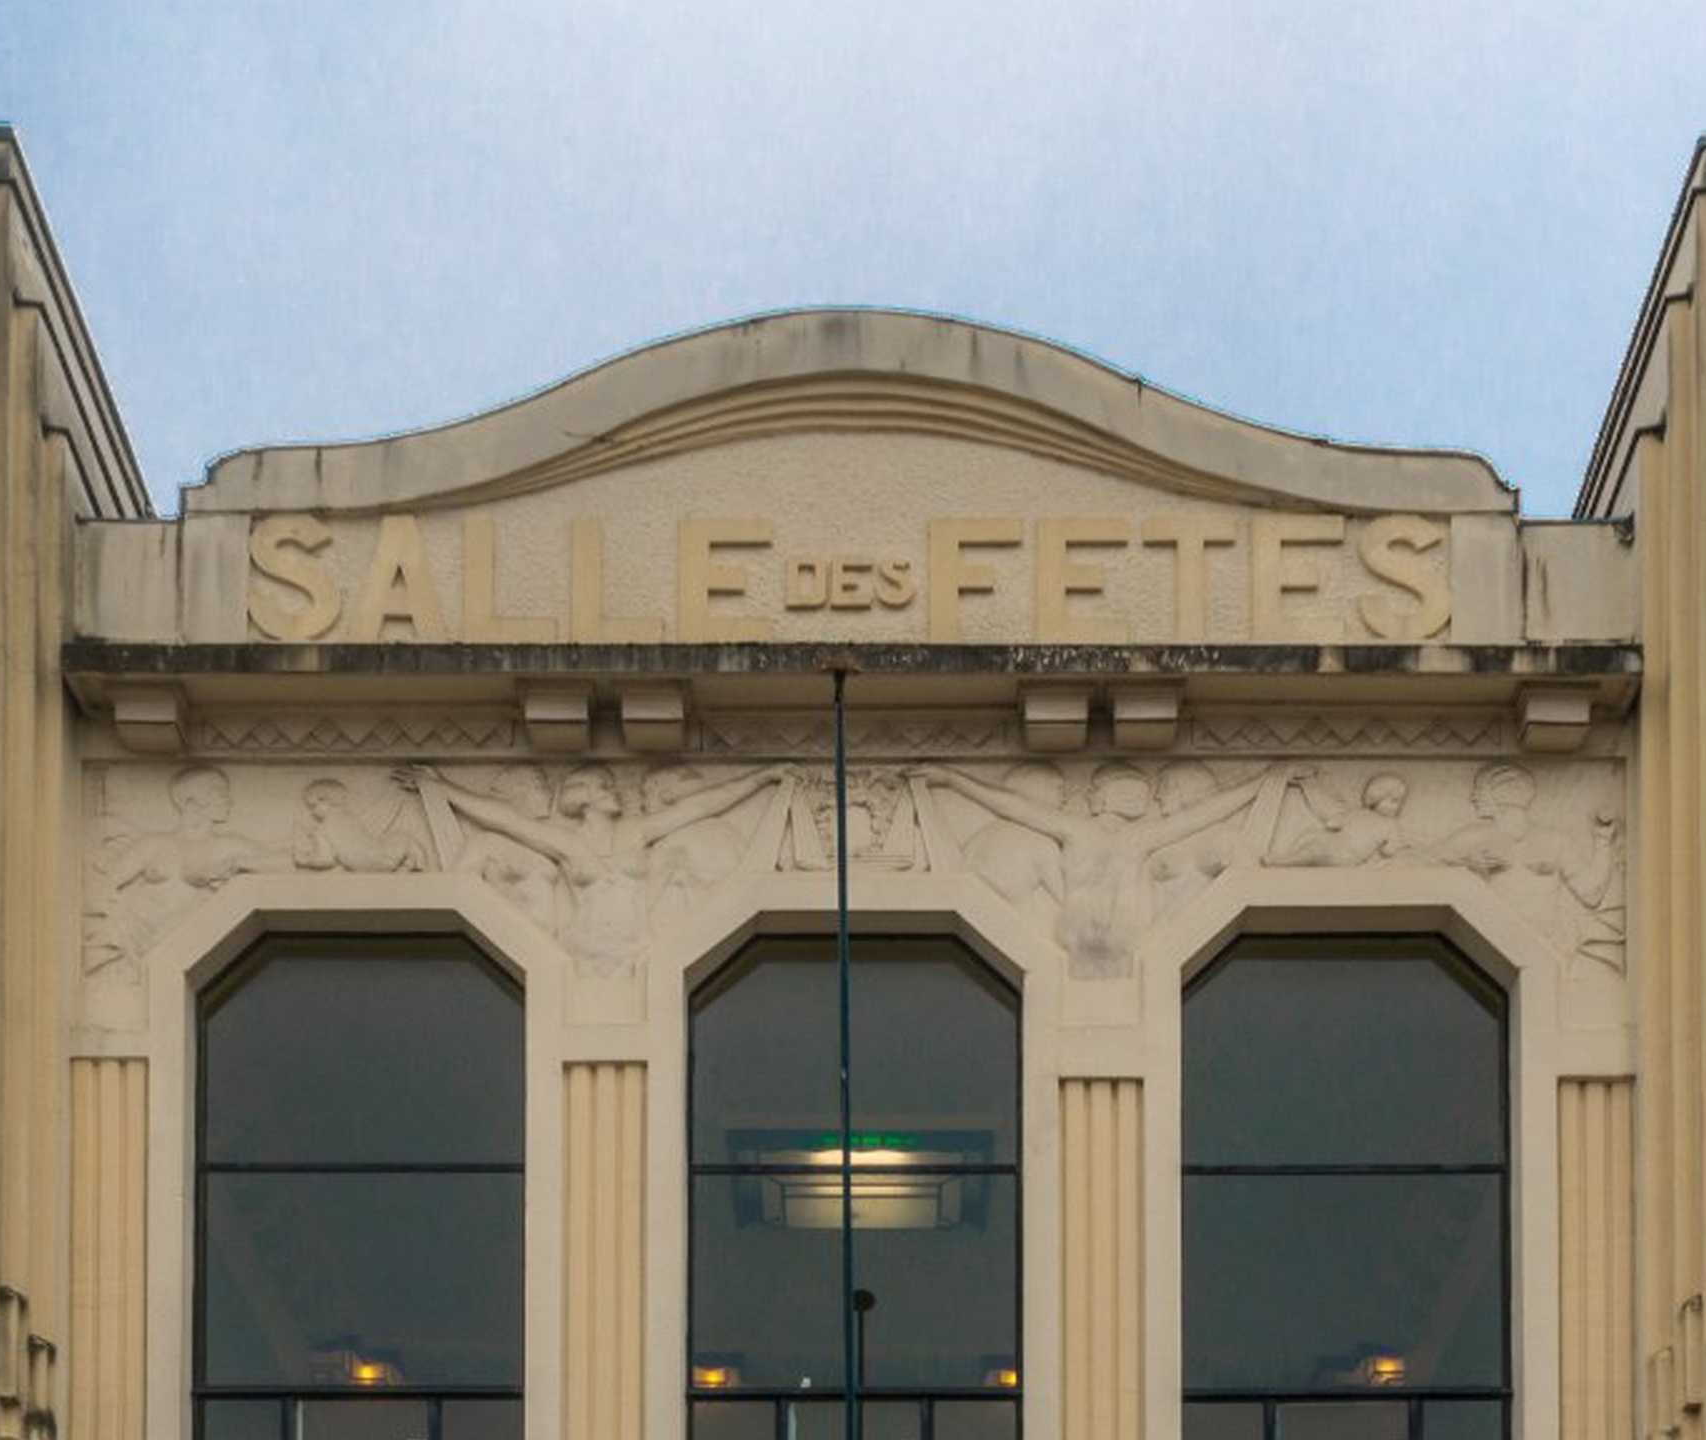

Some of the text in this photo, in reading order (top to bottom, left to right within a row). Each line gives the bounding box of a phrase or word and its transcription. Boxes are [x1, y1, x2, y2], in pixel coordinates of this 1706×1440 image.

[248, 513, 1451, 641] SALLE DES FETES
